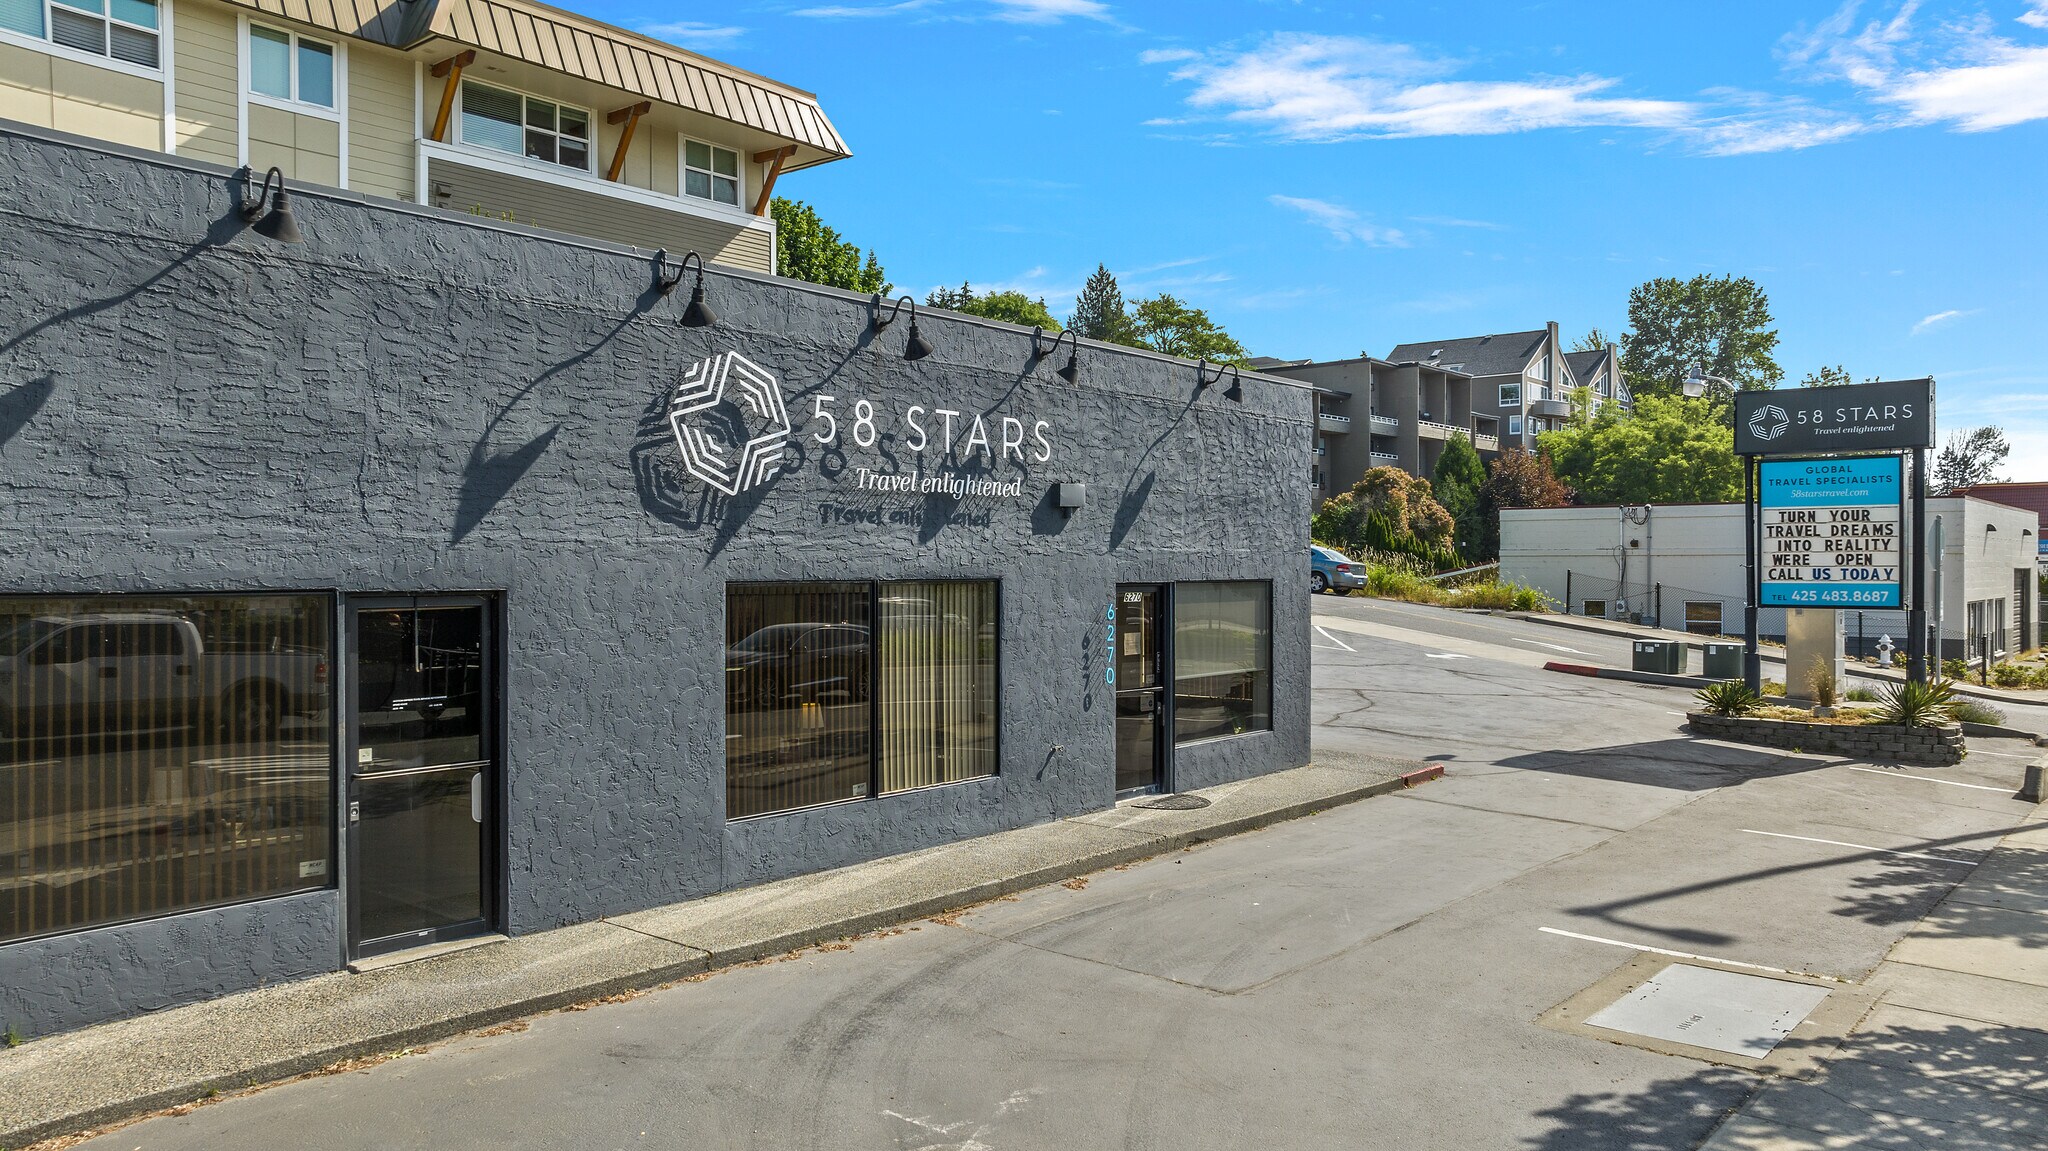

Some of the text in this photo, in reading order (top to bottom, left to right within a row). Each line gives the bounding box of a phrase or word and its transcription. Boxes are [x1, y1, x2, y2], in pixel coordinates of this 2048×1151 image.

[1797, 404, 1913, 425] 58 STARS
[813, 394, 1051, 462] 58 STARS
[1813, 424, 1895, 435] Travel enlightened
[1805, 465, 1853, 475] GLOBAL
[856, 468, 1022, 500] Travel enlightened
[1768, 475, 1893, 487] TRAVEL SPECIALISTS
[1790, 488, 1869, 498] 58starstravel.com
[1779, 510, 1871, 523] TURN YOUR
[1766, 523, 1894, 537] TRAVEL DREAMS
[1778, 538, 1891, 552] INTO REALITY
[1772, 553, 1873, 566] WERE OPEN
[1768, 568, 1894, 580] CALL US TODAY
[1125, 592, 1141, 601] 6270
[1791, 590, 1817, 601] 425
[1821, 590, 1889, 602] 483.8687
[1106, 603, 1115, 684] 6270
